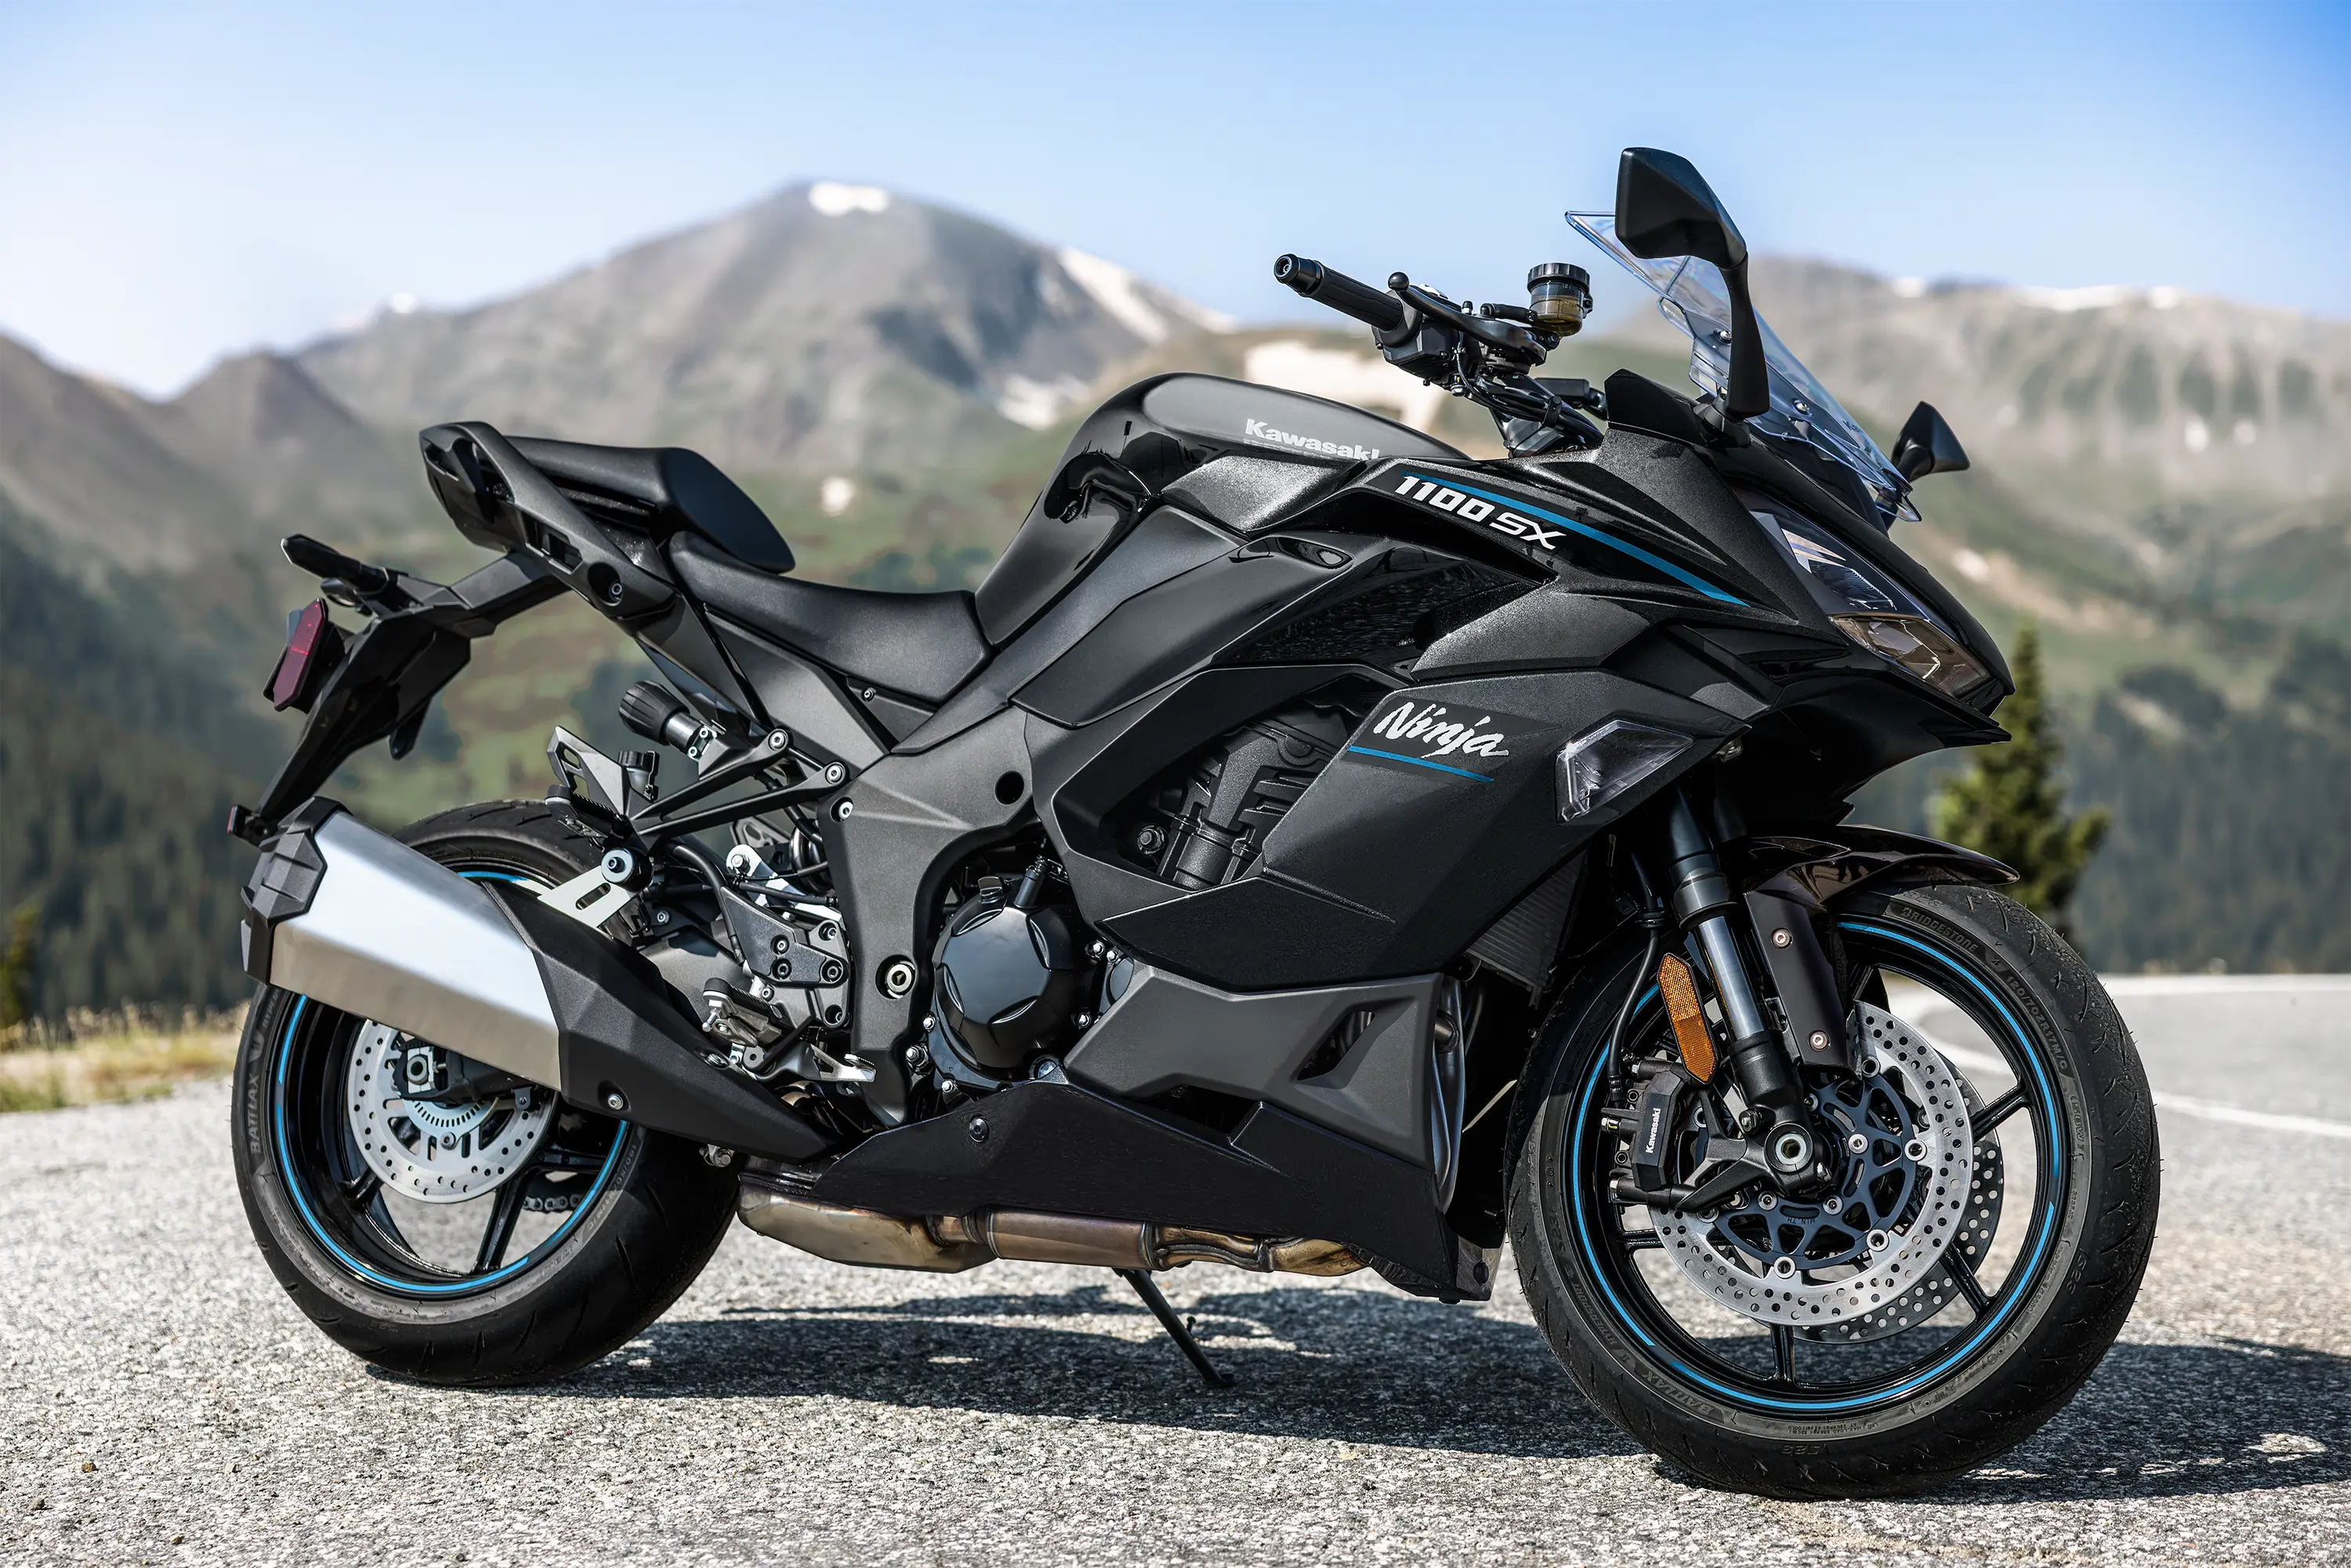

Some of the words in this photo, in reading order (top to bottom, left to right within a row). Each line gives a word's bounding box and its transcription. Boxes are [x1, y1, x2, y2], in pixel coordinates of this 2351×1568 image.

[1245, 418, 1380, 461] Kawasaki
[1394, 476, 1496, 523] 1100
[1489, 512, 1567, 550] SX
[1373, 701, 1509, 759] Ninja
[1901, 907, 1980, 954] BRIDGESTONE
[247, 1073, 262, 1155] BATTLAX
[1645, 1107, 1661, 1154] Kawasaki
[1570, 1283, 1619, 1346] HYPERSPORT
[1644, 1370, 1716, 1416] BATTLAX
